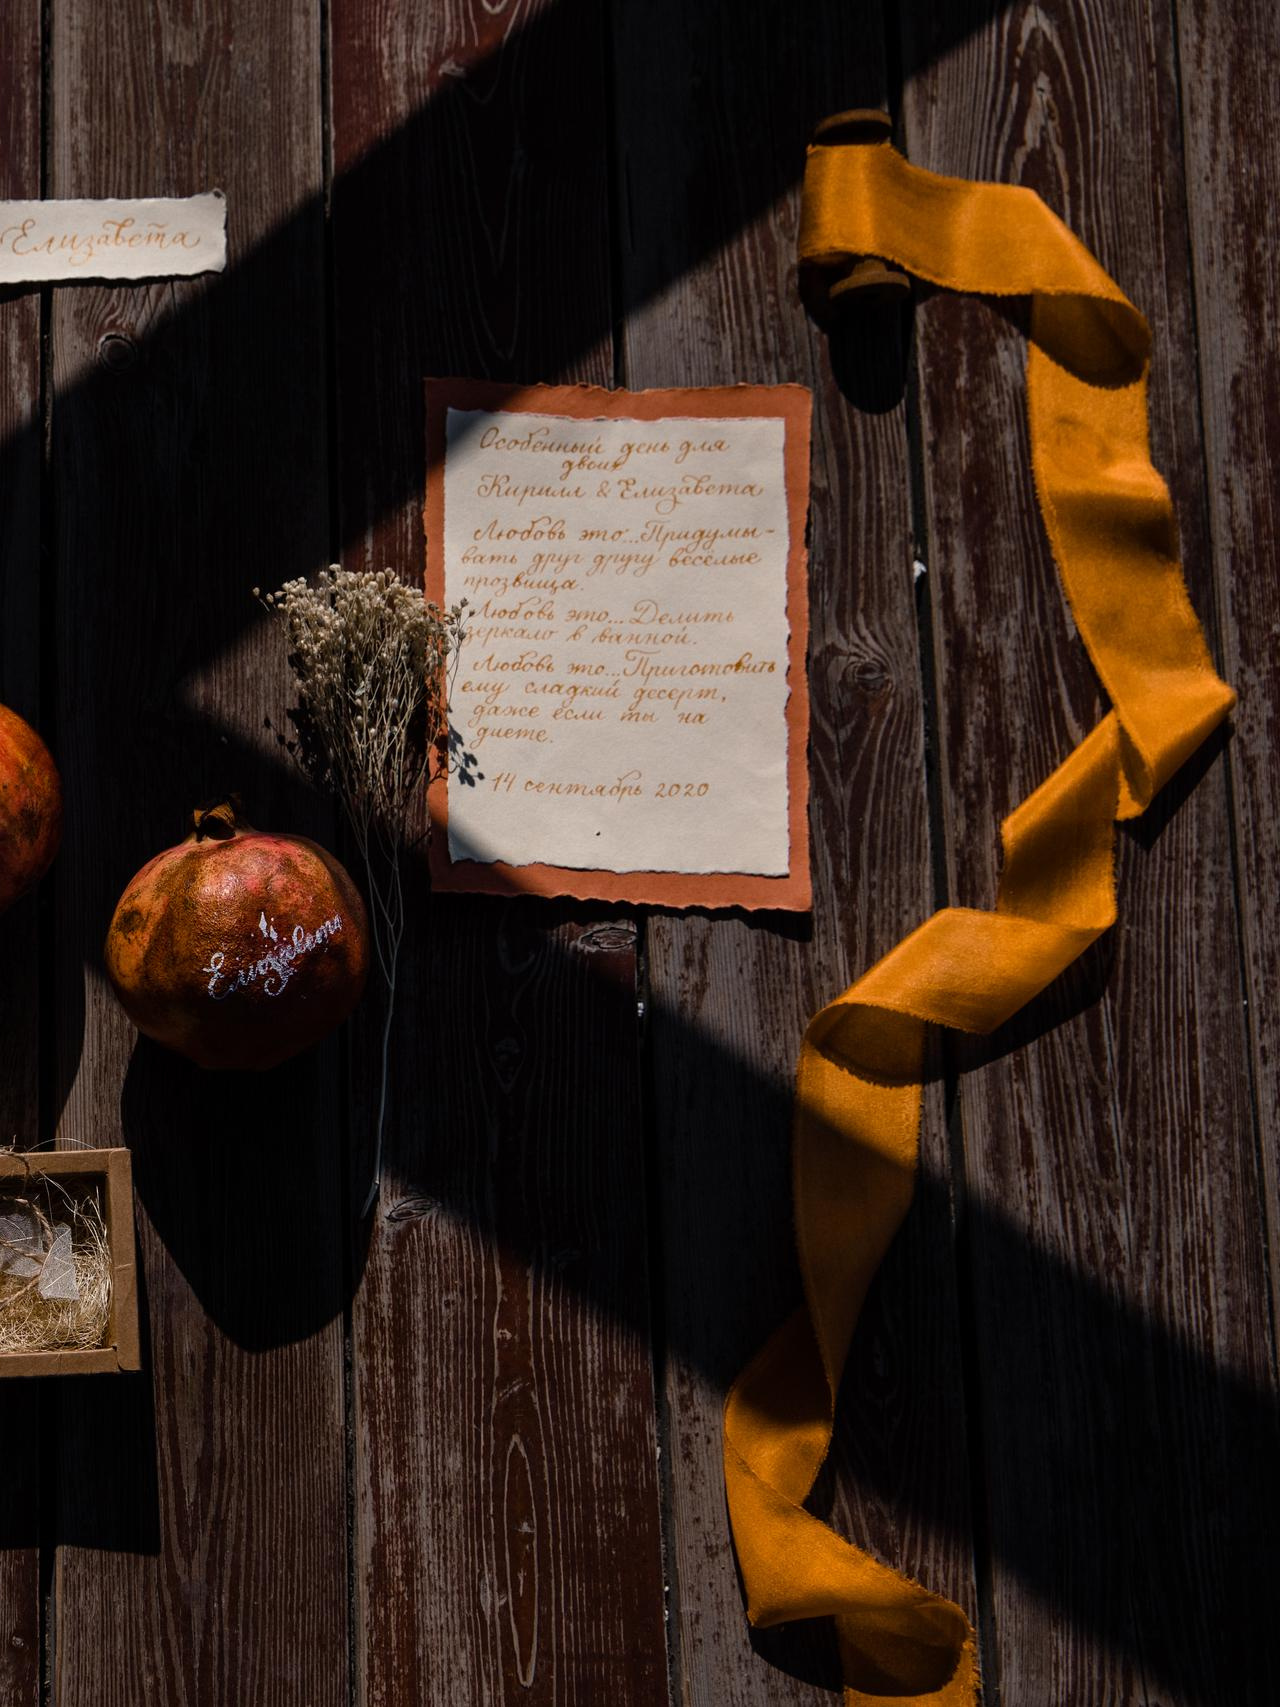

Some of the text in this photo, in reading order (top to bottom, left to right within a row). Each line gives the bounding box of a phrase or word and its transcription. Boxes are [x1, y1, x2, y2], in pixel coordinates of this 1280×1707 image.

[0, 217, 201, 267] Елизавета
[479, 427, 730, 465] Особенный день для
[559, 456, 626, 480] двоих
[477, 474, 764, 514] Кирилл & Елизавета
[473, 515, 566, 541] Любовь
[461, 546, 519, 565] вать
[527, 552, 584, 576] друг
[586, 552, 660, 577] другу
[464, 571, 584, 596] прозвища.
[474, 596, 555, 620] Любовь
[630, 598, 735, 625] Делить
[462, 622, 697, 647] зеркало в ванной.
[473, 650, 555, 672] Любовь
[623, 649, 776, 688] Приготовить
[461, 679, 726, 710] ему сладкий десерт,
[468, 702, 707, 727] даже если ты на
[470, 725, 554, 749] диете.
[492, 770, 710, 803] 14 сентябрь 2020
